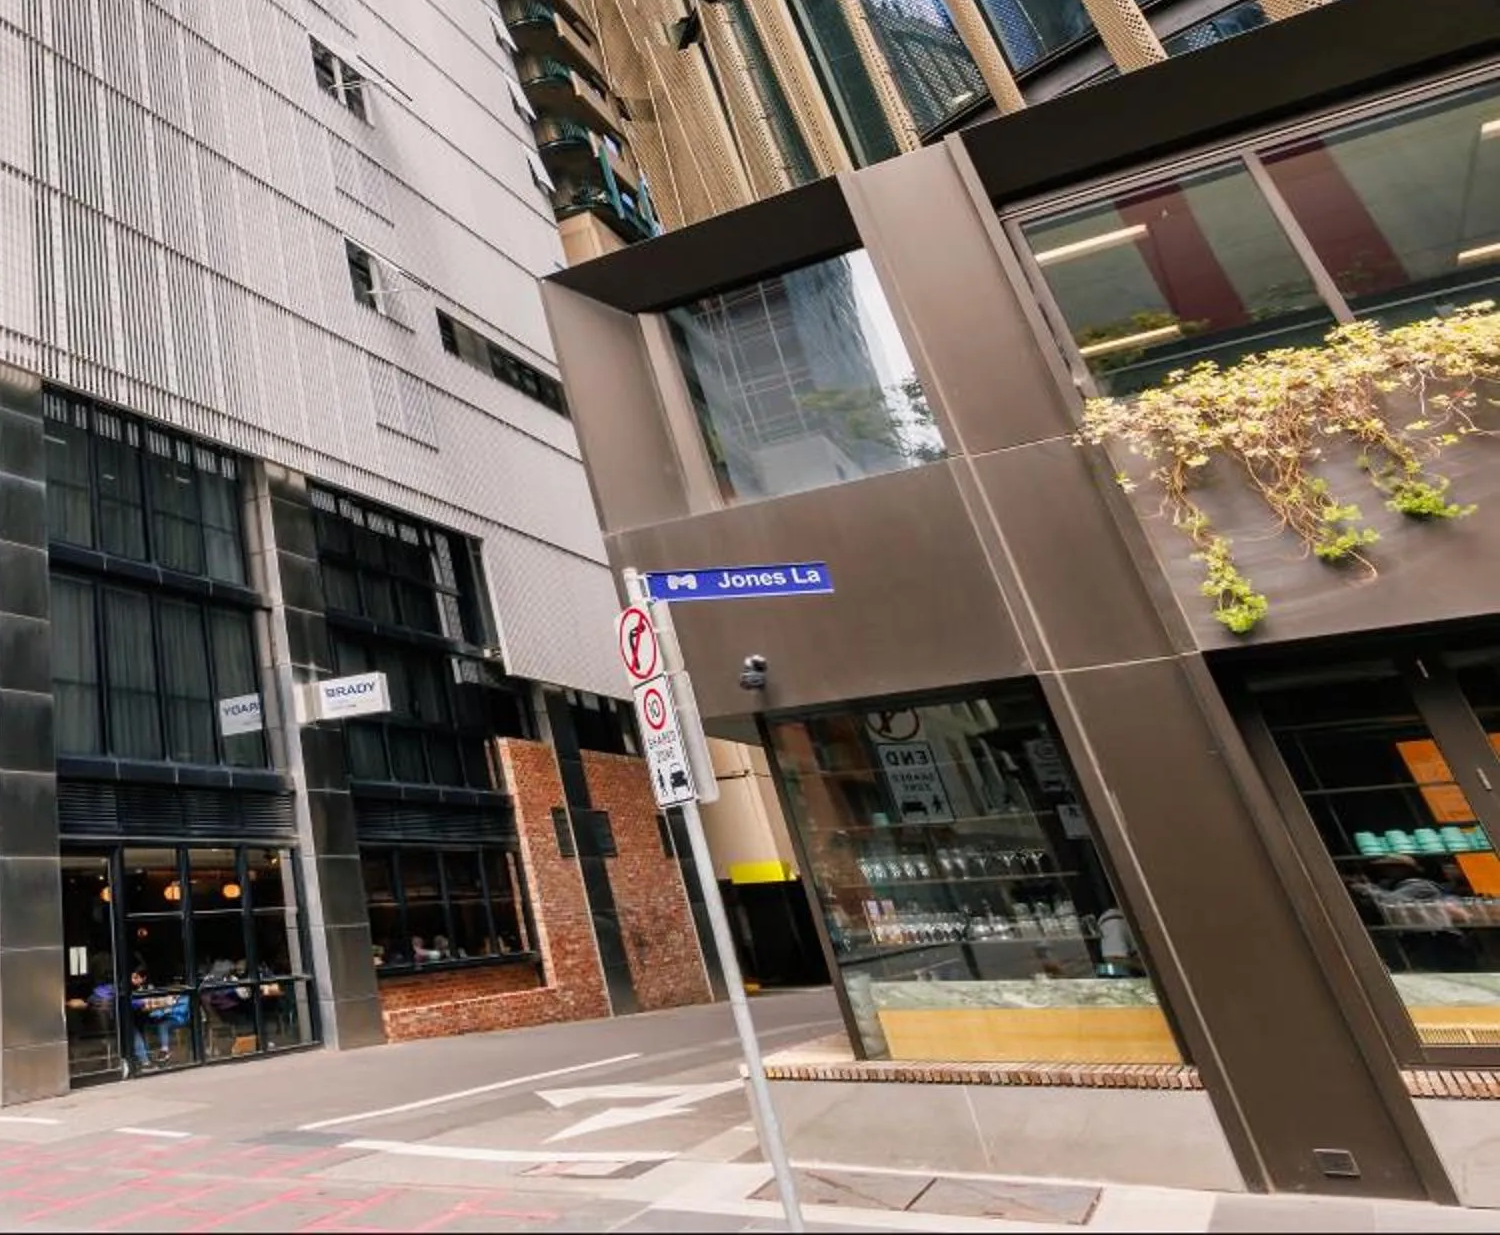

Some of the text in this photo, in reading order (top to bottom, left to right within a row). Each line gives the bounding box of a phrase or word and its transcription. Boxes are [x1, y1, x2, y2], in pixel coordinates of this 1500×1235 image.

[718, 567, 821, 588] Jones La
[325, 682, 376, 698] BRADY
